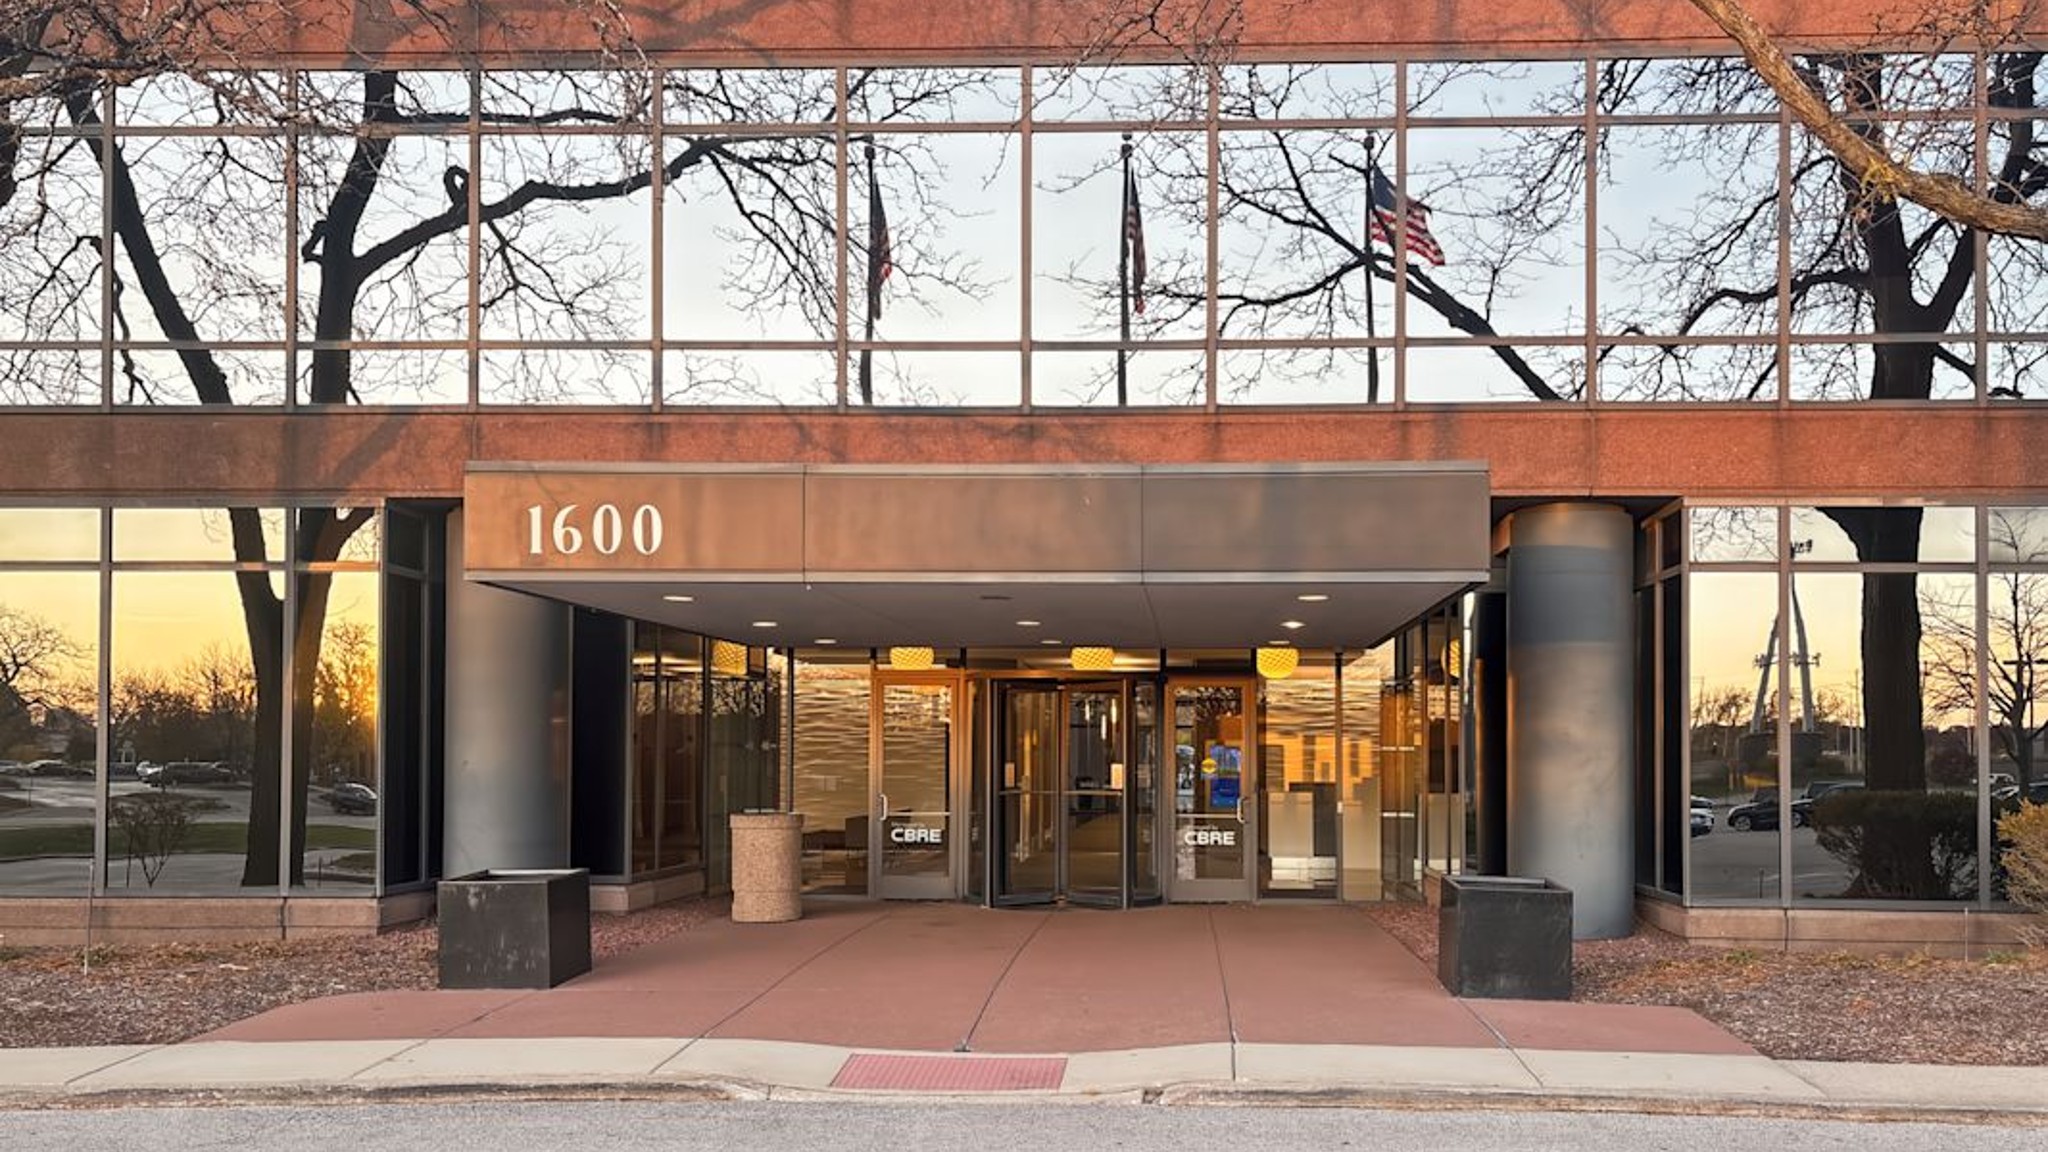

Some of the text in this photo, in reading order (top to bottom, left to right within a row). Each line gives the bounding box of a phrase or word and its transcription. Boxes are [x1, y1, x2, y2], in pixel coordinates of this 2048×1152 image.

[527, 504, 663, 555] 1600
[890, 828, 942, 843] CBRE
[1184, 830, 1236, 846] CBRE
